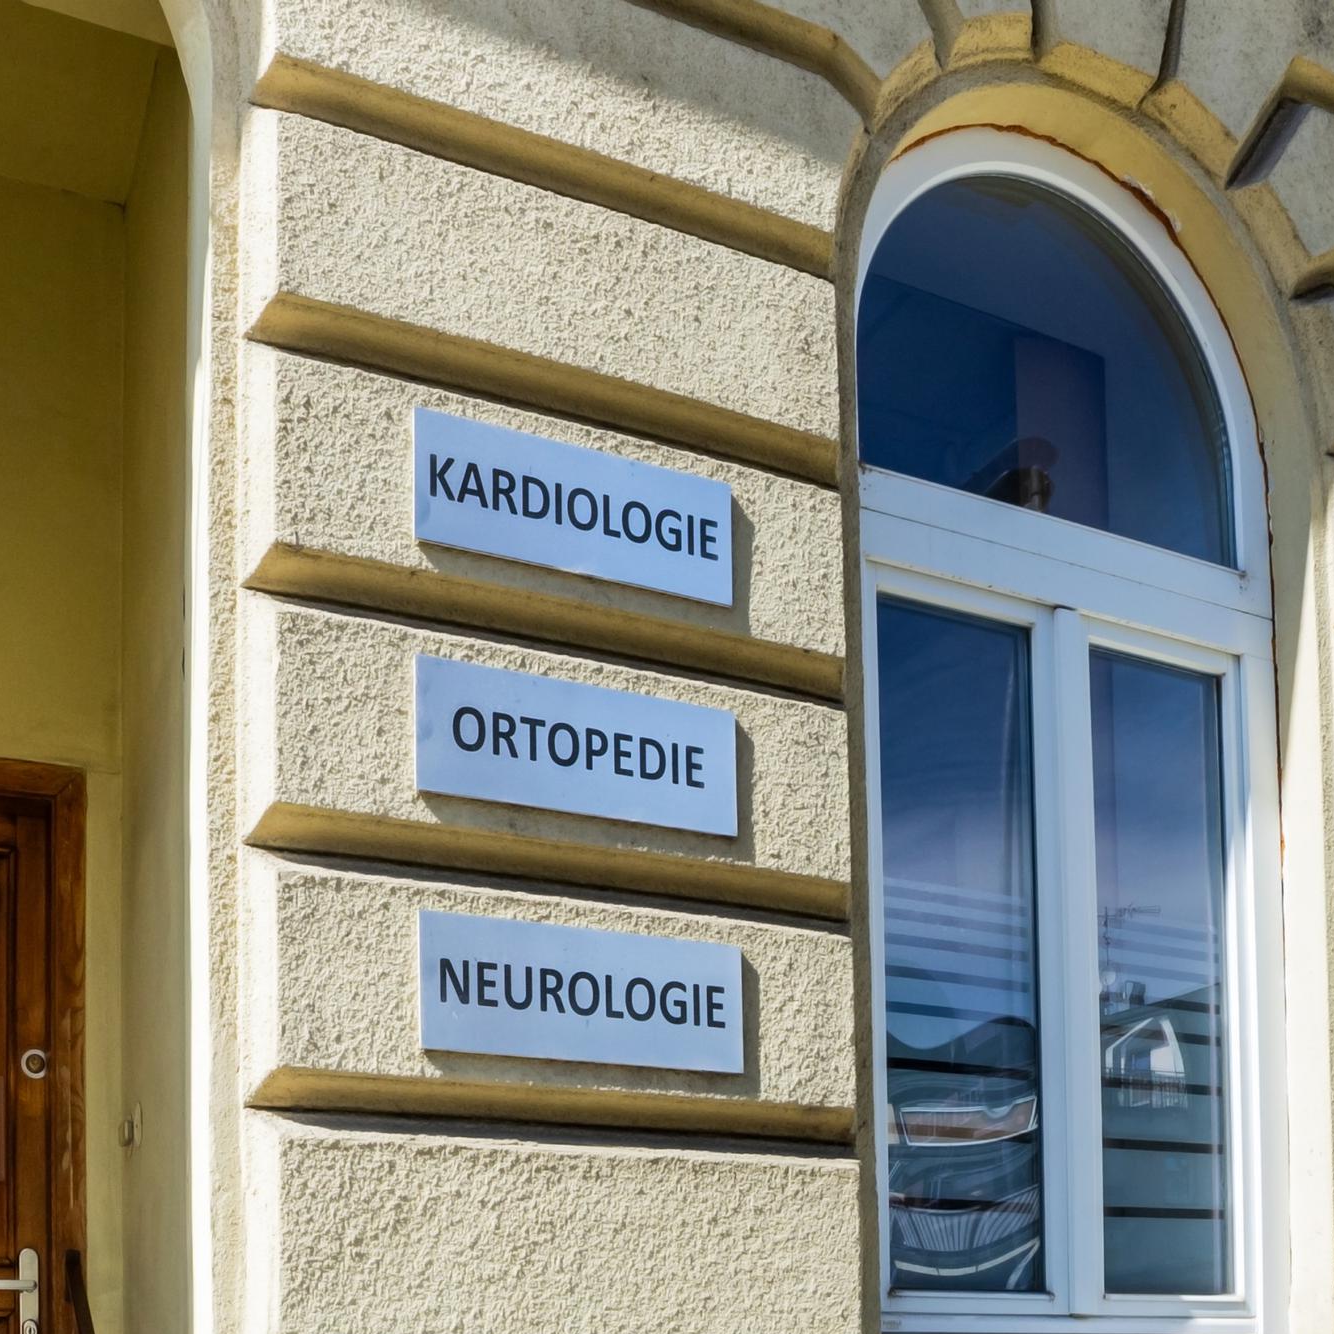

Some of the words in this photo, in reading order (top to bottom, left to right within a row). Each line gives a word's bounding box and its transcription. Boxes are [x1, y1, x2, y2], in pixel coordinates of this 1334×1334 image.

[429, 453, 719, 561] KARDIOLOGIE
[452, 706, 705, 789] ORTOPEDIE
[439, 957, 726, 1029] NEUROLOGIE
